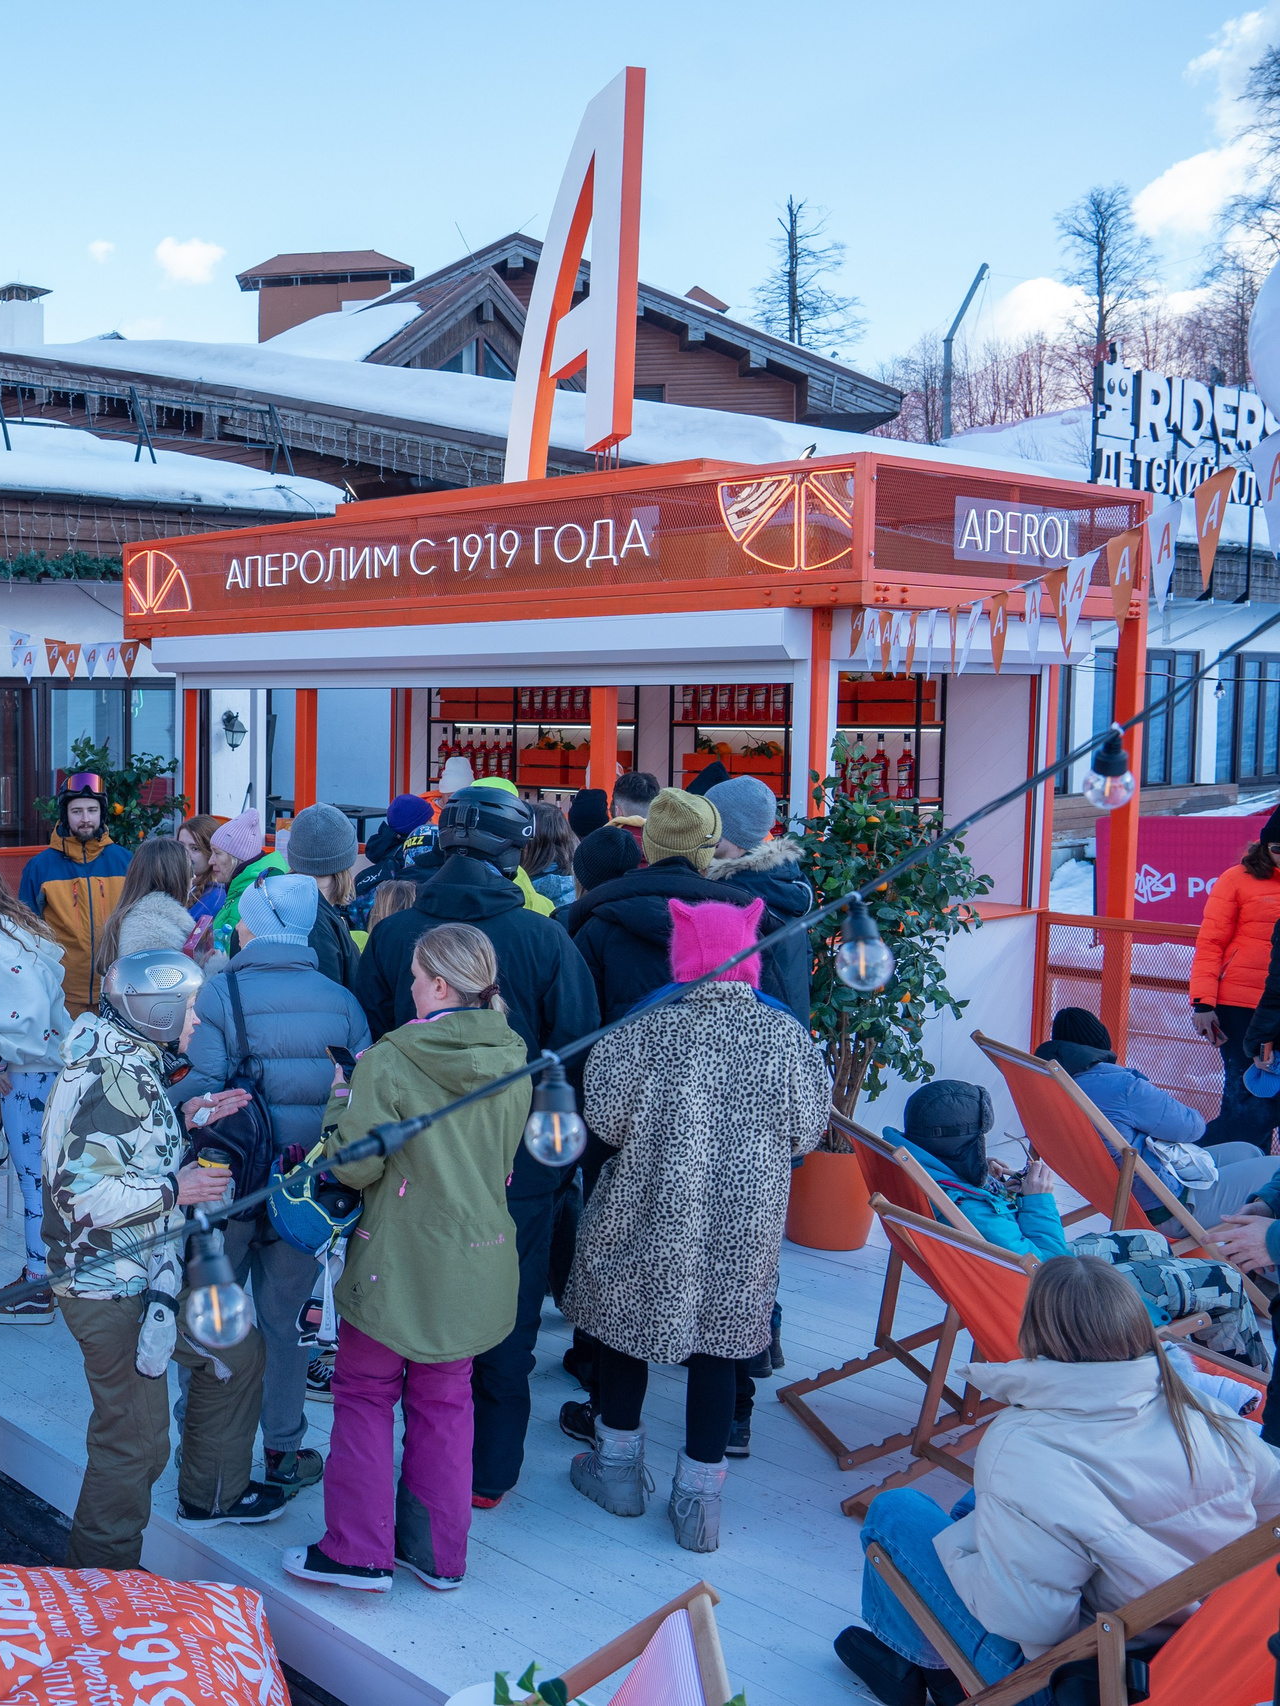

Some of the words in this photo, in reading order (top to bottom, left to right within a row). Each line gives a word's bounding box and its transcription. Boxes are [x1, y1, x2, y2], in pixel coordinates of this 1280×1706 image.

[225, 543, 400, 591] АПЕРОЛИМ
[409, 538, 438, 576] С
[446, 529, 521, 573] 1919
[533, 518, 651, 569] ГОДА
[959, 508, 1077, 560] APEROL
